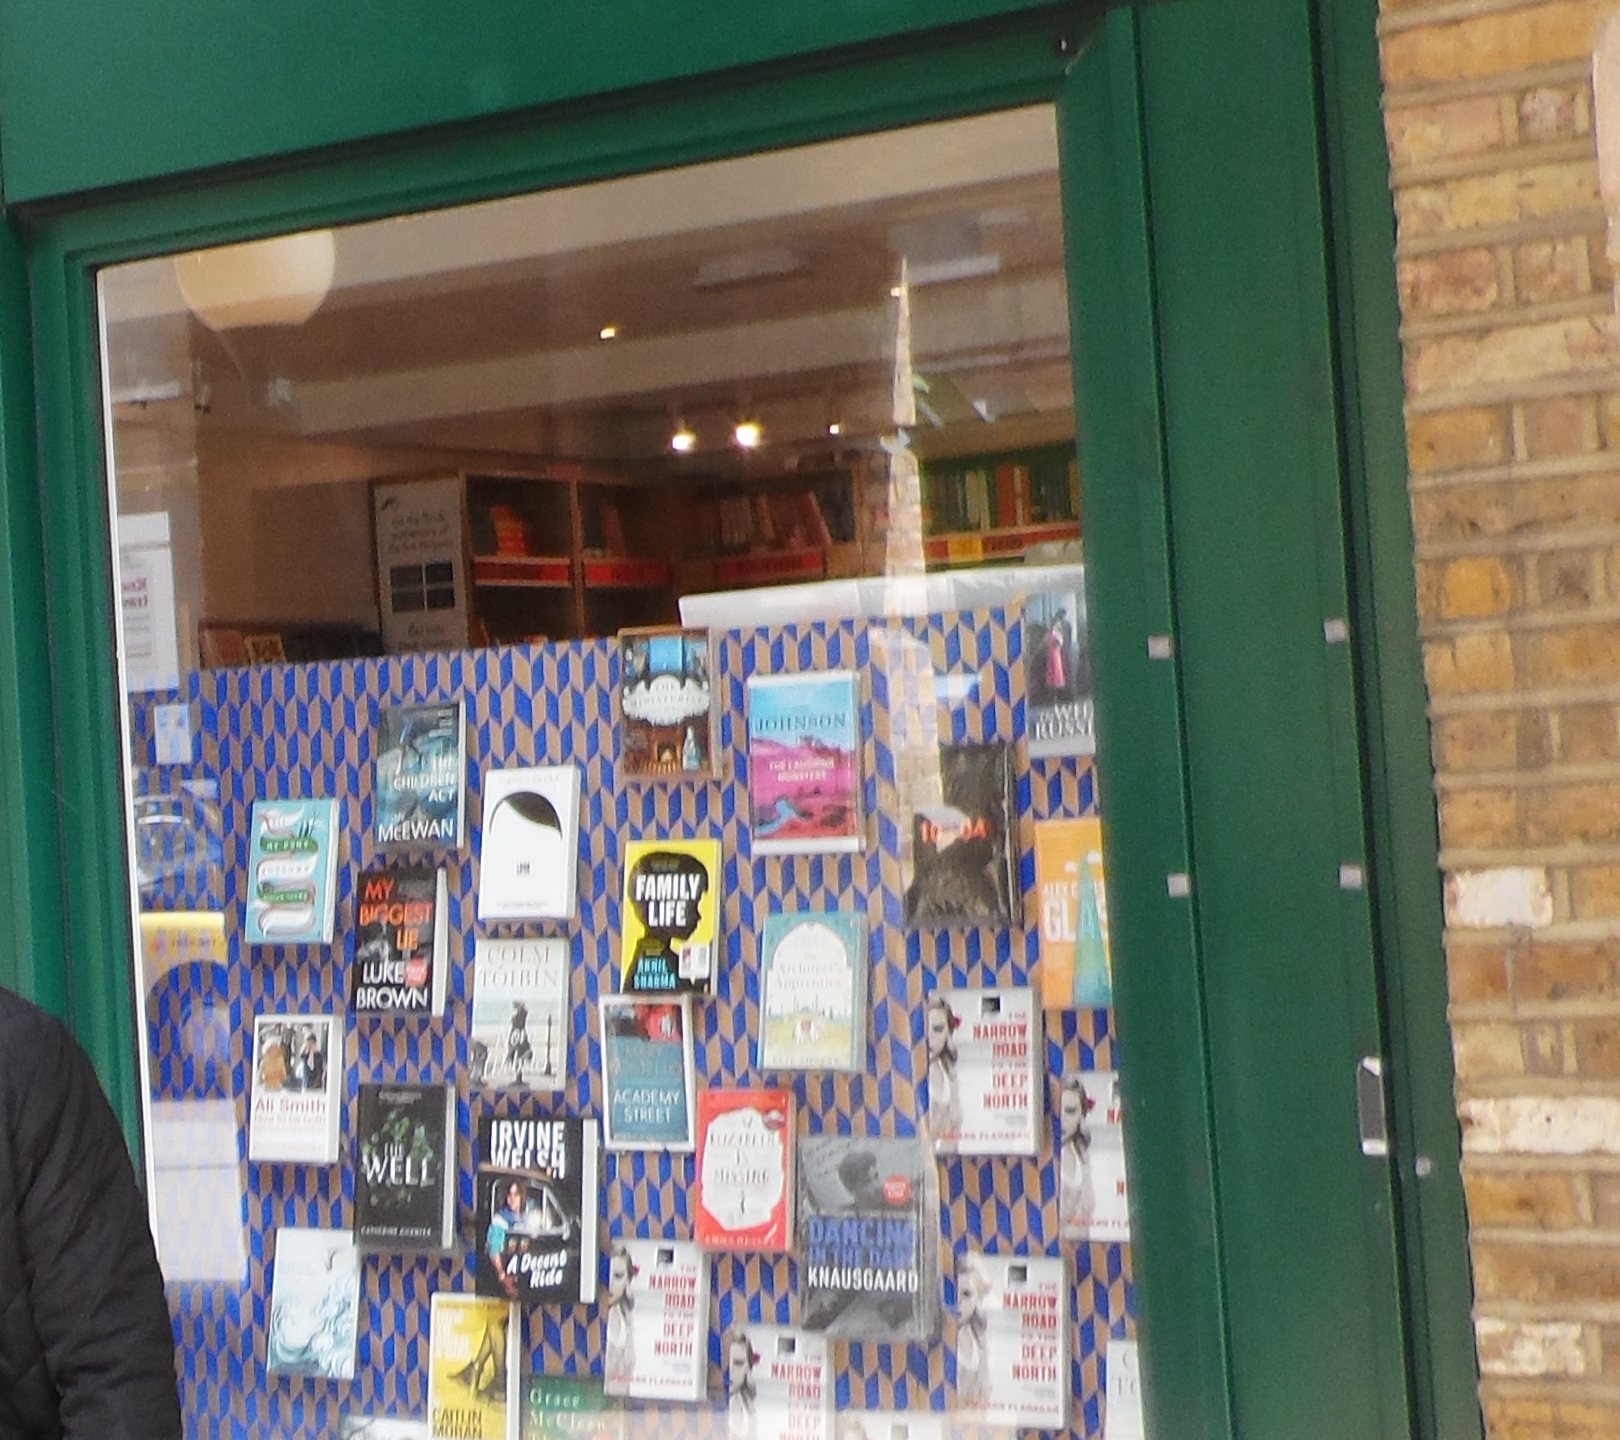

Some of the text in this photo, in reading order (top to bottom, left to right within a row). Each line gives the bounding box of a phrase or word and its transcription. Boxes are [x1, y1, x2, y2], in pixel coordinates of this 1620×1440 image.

[755, 713, 846, 733] JOHNSON
[393, 771, 455, 790] CHILDREN
[428, 788, 454, 803] ACT
[365, 878, 395, 900] MY
[635, 873, 701, 901] FAMILY
[360, 901, 434, 927] BIGGEST
[648, 900, 687, 927] LIFE
[396, 928, 419, 951] LIE
[363, 961, 405, 984] LUKE
[356, 986, 428, 1010] BROWN
[973, 1023, 1028, 1041] NARROW
[993, 1042, 1028, 1058] ROAD
[992, 1073, 1028, 1089] DEEP
[255, 1097, 275, 1113] Ali
[280, 1096, 327, 1114] Smith
[614, 1088, 681, 1106] ACADEMY
[983, 1092, 1028, 1110] NORTH
[624, 1106, 671, 1124] STREET
[491, 1119, 566, 1150] IRVINE
[362, 1153, 436, 1188] WELL
[714, 1167, 771, 1185] MISSING
[507, 1253, 518, 1275] A
[520, 1248, 568, 1273] Decent
[530, 1267, 564, 1289] Ride
[648, 1274, 697, 1292] NARROW
[808, 1265, 919, 1293] KNAUSGAARD
[664, 1293, 696, 1309] ROAD
[1002, 1292, 1057, 1310] NARROW
[1022, 1313, 1057, 1329] ROAD
[663, 1323, 695, 1338] DEEP
[654, 1340, 693, 1357] NORTH
[1022, 1344, 1057, 1360] DEEP
[770, 1363, 822, 1381] NARROW
[1012, 1363, 1057, 1382] NORTH
[529, 1386, 581, 1409] Grace
[788, 1383, 821, 1399] ROAD
[529, 1410, 606, 1431] McCleen
[788, 1414, 821, 1430] DEEP
